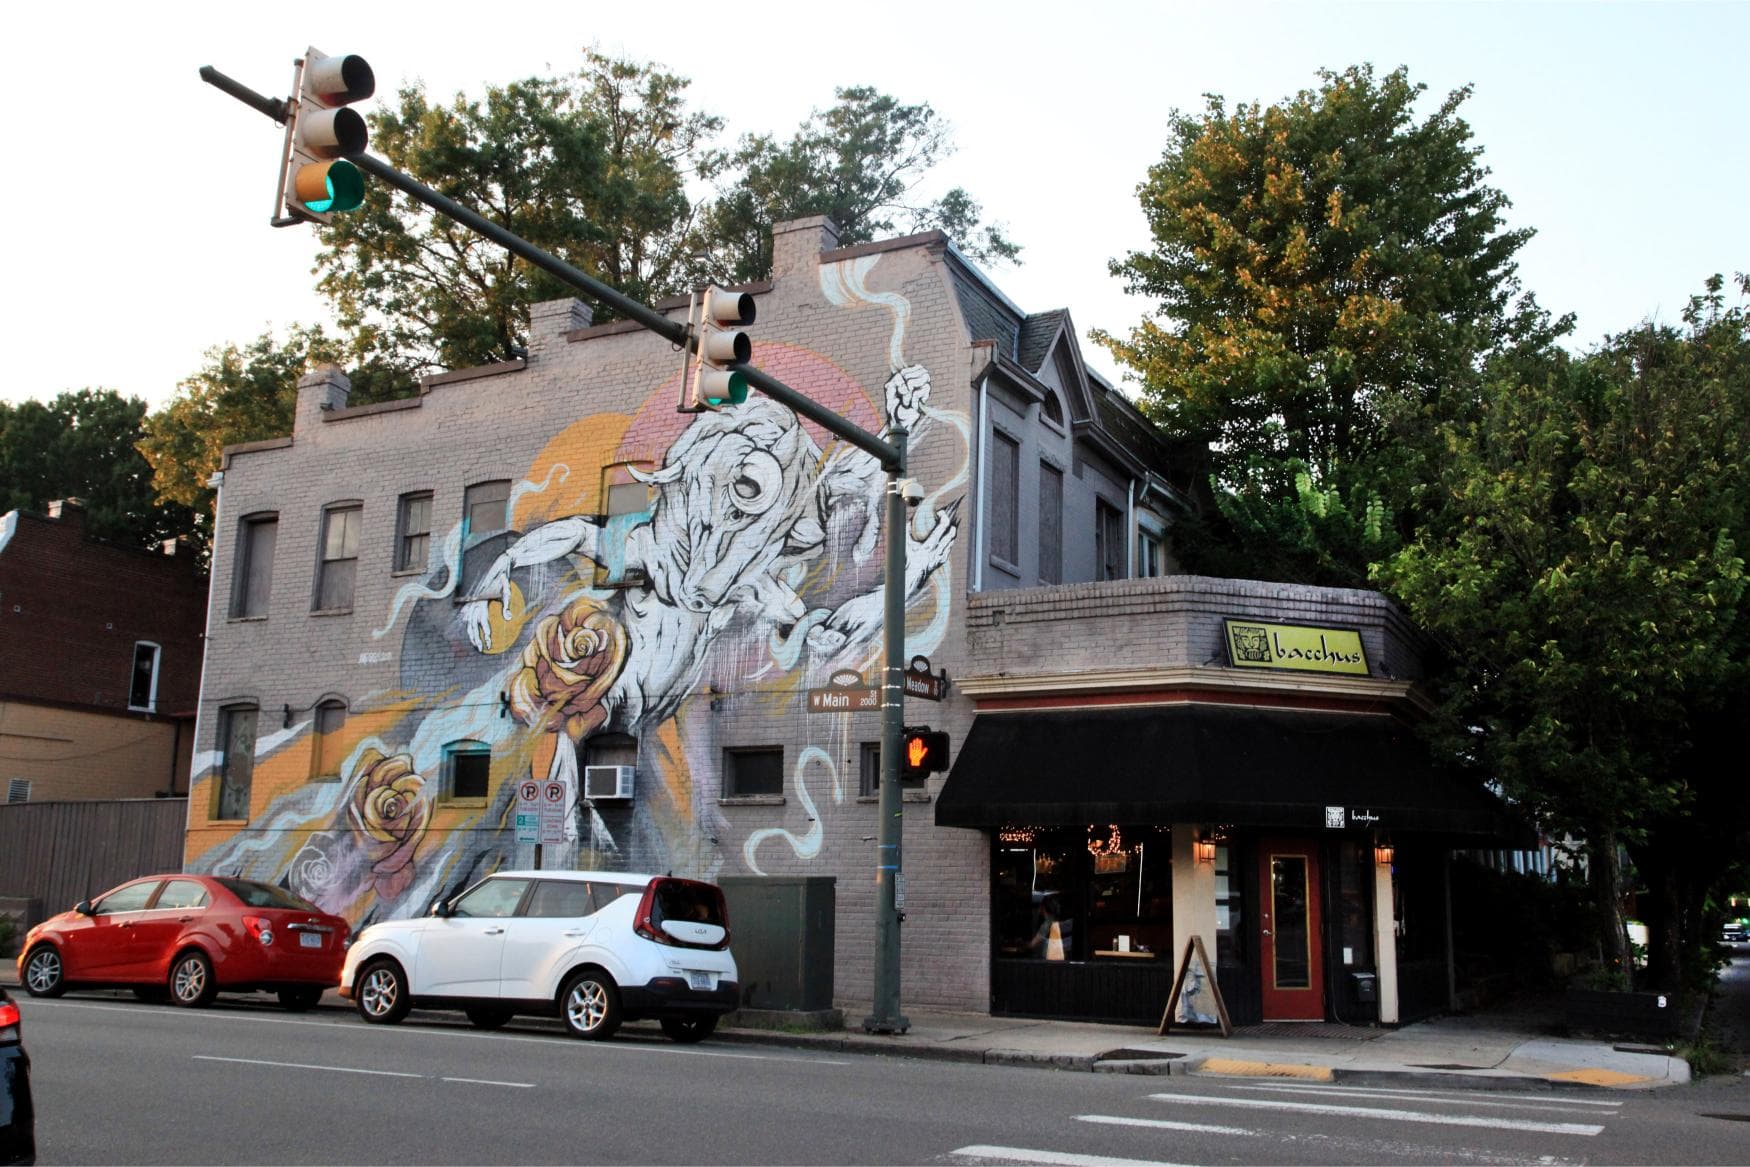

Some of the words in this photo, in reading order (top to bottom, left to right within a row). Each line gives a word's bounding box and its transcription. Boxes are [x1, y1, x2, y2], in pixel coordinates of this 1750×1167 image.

[1273, 632, 1361, 665] bacchus
[906, 675, 930, 695] Meadow
[813, 695, 821, 706] W
[822, 692, 849, 707] Main
[869, 690, 877, 698] St
[860, 697, 877, 706] 2000
